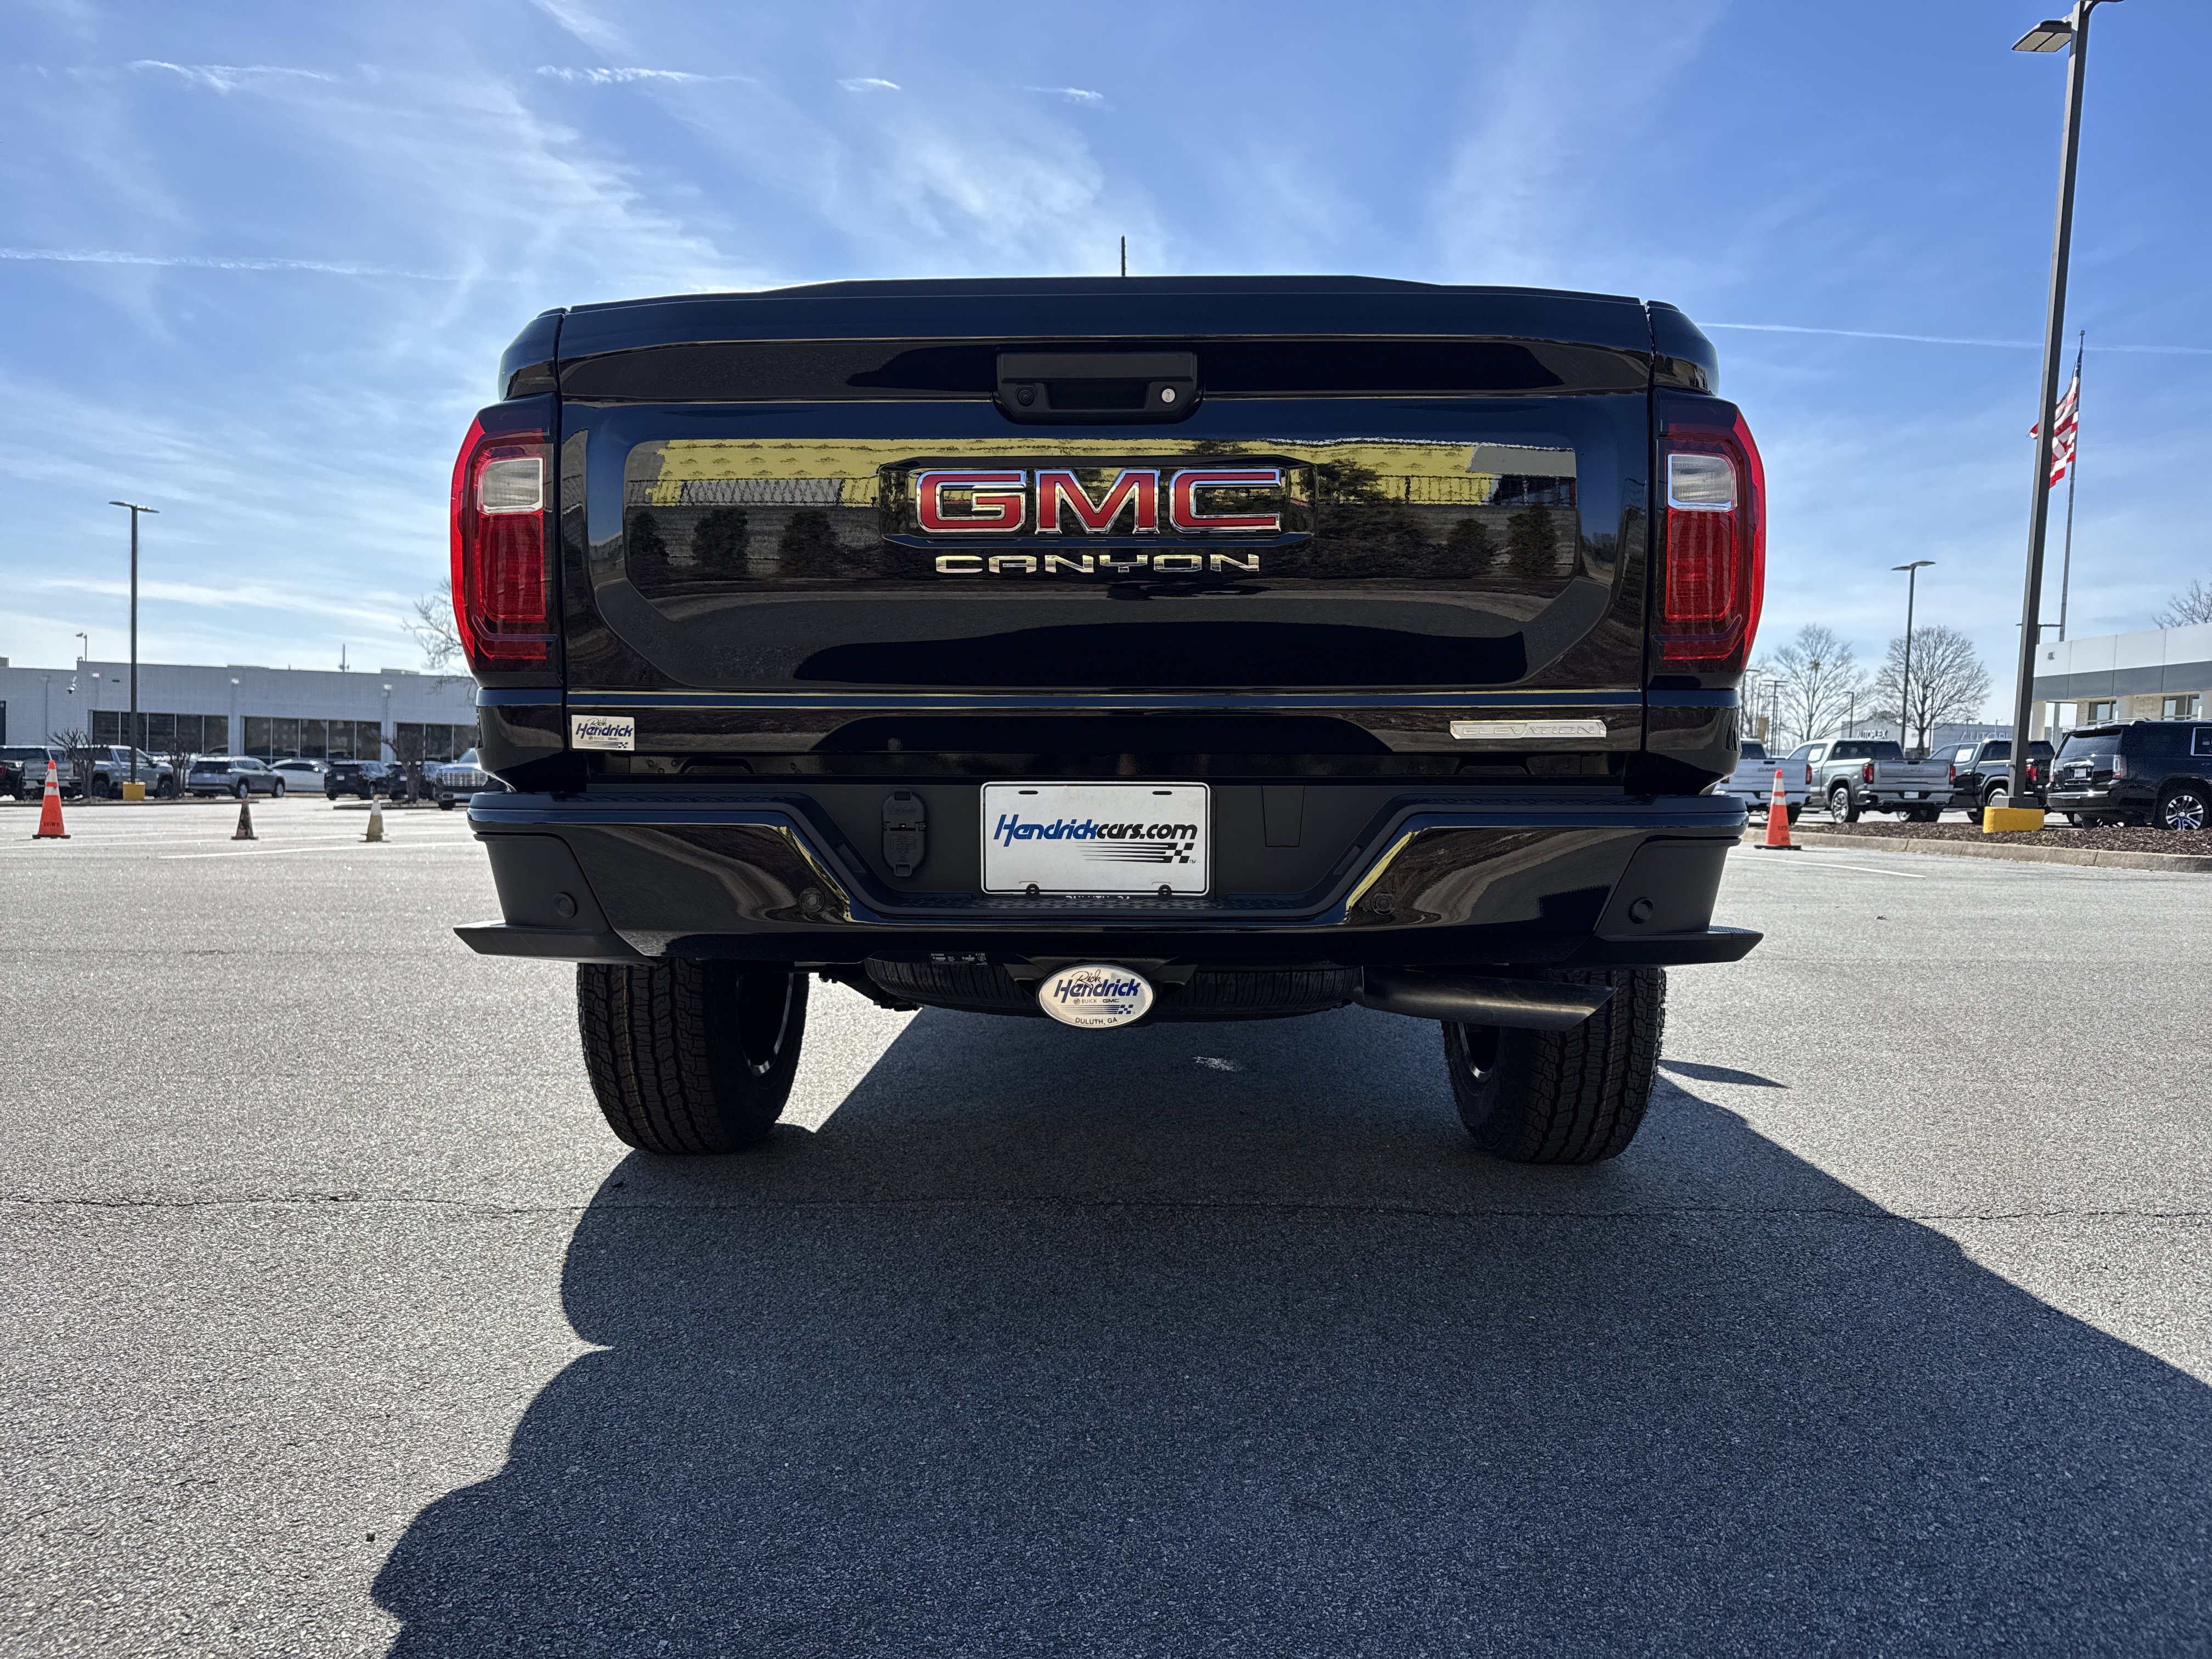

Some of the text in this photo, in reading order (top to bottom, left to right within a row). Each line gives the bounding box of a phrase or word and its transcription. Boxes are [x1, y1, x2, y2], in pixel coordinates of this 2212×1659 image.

[916, 469, 1282, 534] GMC
[935, 554, 1260, 573] CANYON
[575, 723, 634, 739] Hendrick
[587, 718, 607, 729] Rick
[1462, 724, 1594, 735] ELEVATION
[993, 814, 1198, 847] Hendrickcars.com
[1071, 969, 1102, 987] Rick
[1053, 979, 1141, 1003] Hendrick
[1075, 1017, 1105, 1025] DULUTH,
